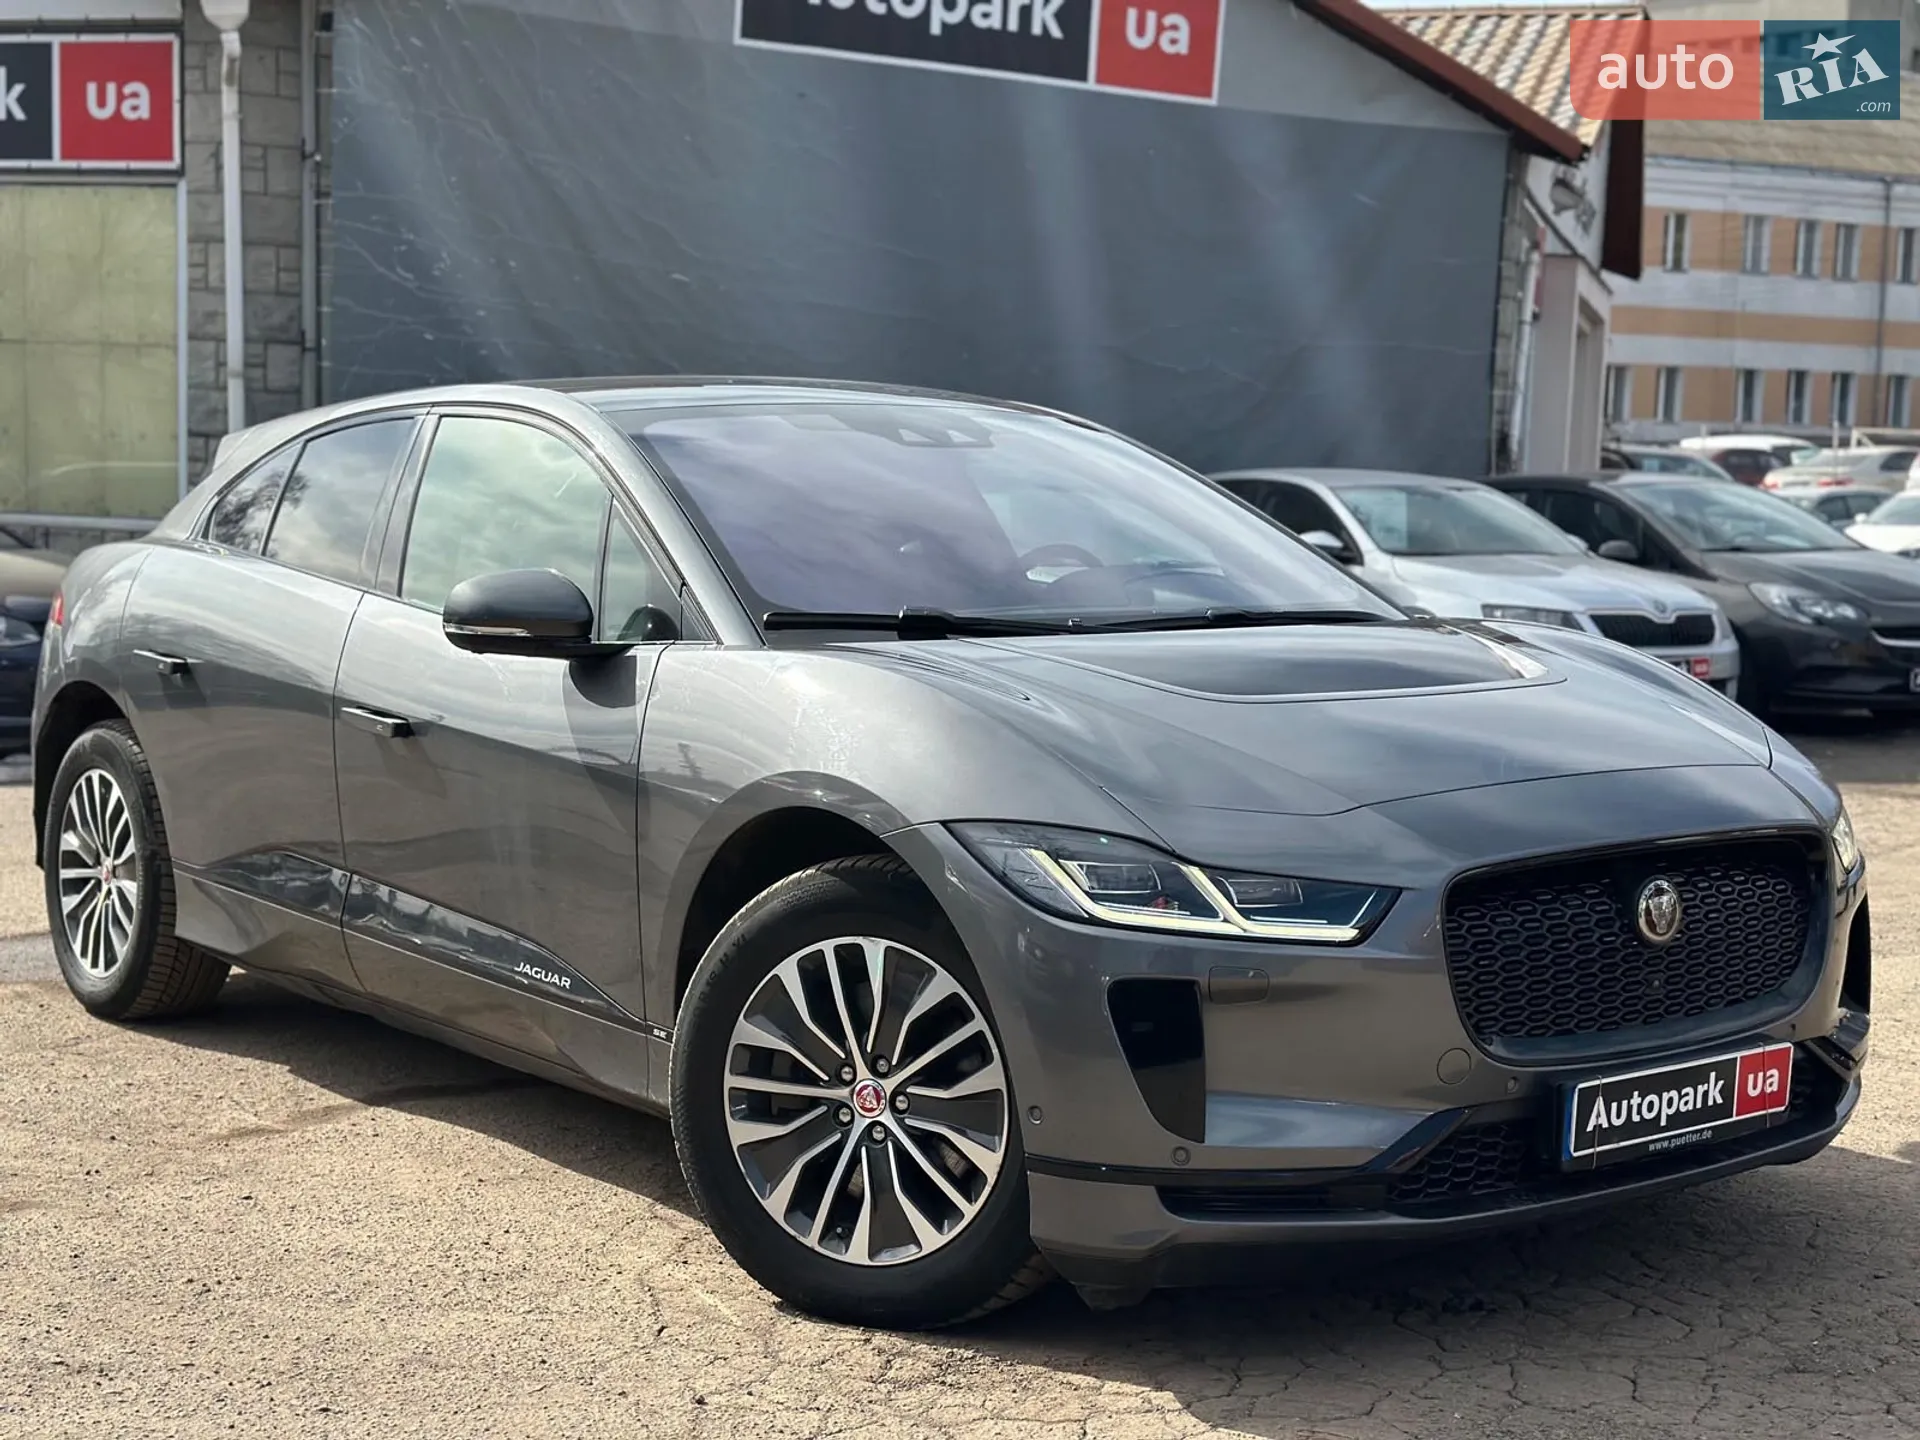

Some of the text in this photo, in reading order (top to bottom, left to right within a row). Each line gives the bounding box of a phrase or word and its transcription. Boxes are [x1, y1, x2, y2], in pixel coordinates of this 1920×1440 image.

[1124, 6, 1191, 55] ua
[86, 81, 151, 121] ua
[513, 961, 572, 990] JAGUAR
[1587, 1067, 1780, 1132] Autopark ua
[1649, 1129, 1713, 1151] www.puetter.de
